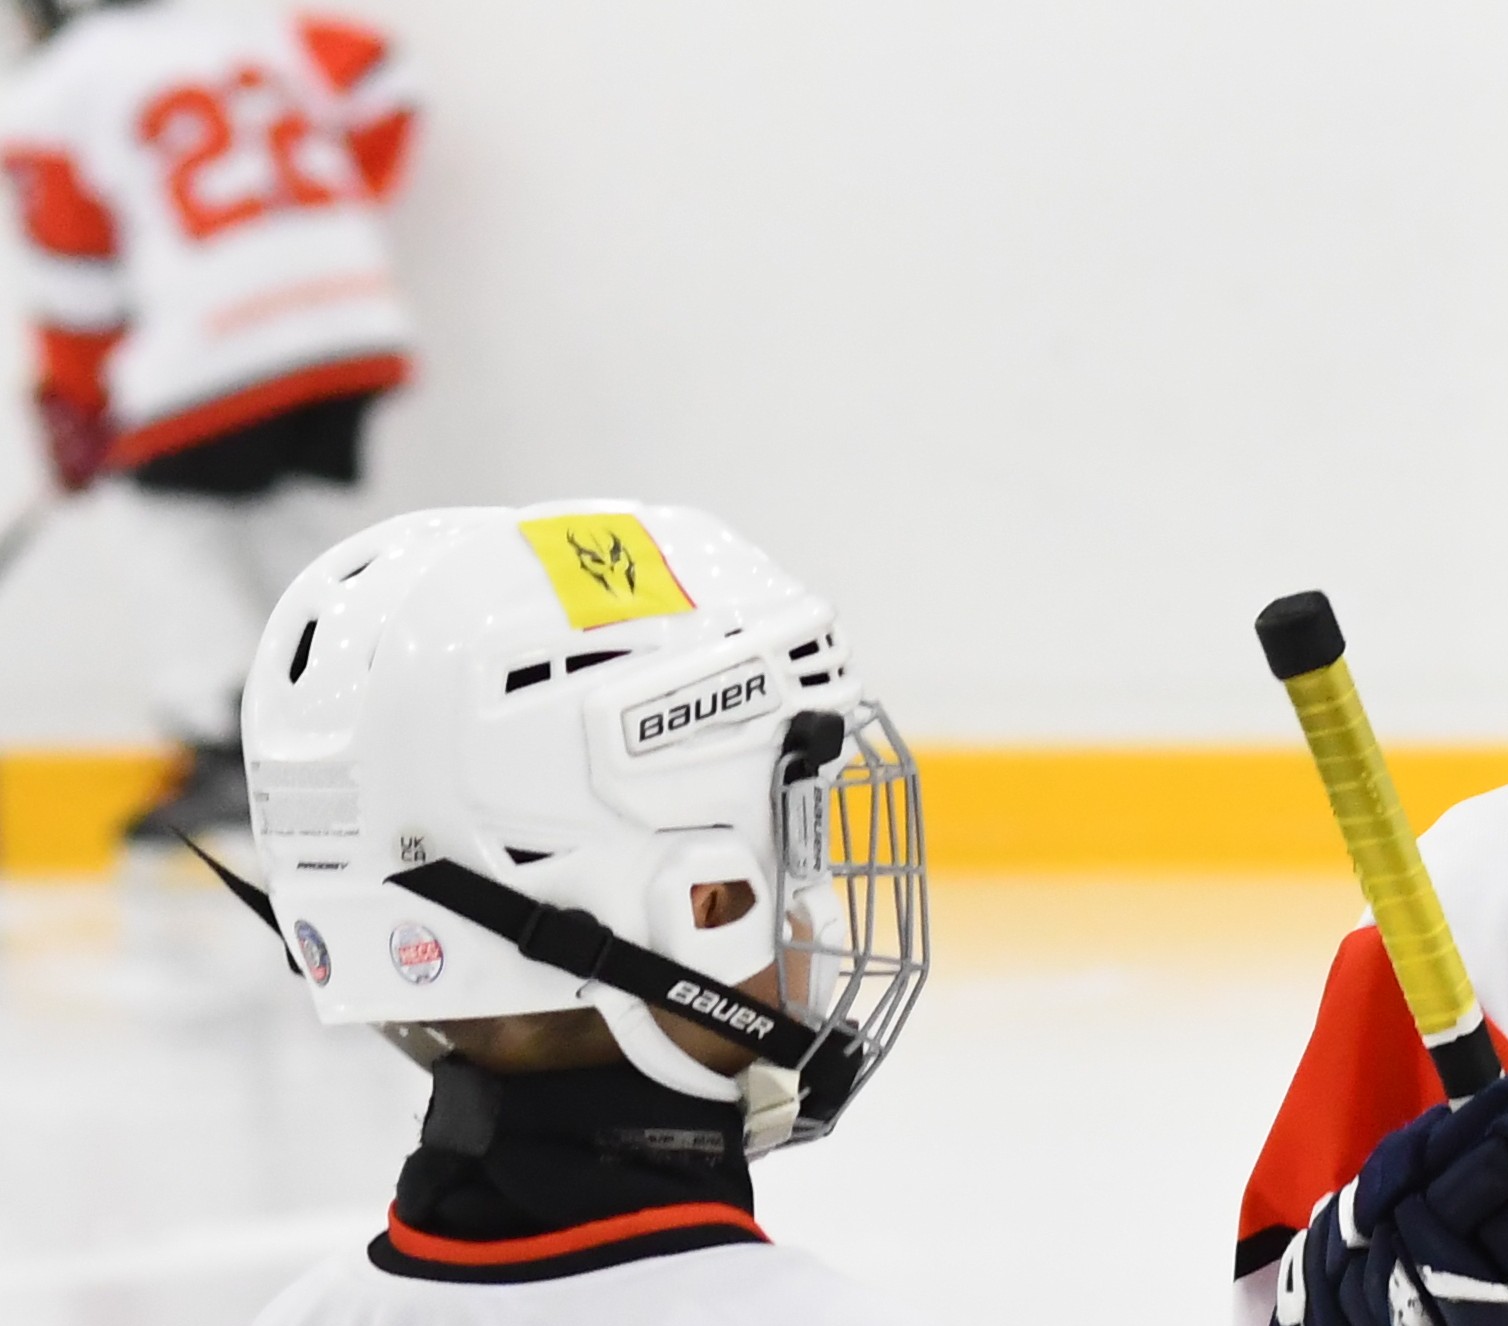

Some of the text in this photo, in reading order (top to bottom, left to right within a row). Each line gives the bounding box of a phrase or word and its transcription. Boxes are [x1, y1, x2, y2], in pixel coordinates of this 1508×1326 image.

[638, 673, 766, 742] BAUER
[400, 836, 425, 850] UK
[401, 850, 427, 863] CA
[666, 980, 775, 1040] BAUER
